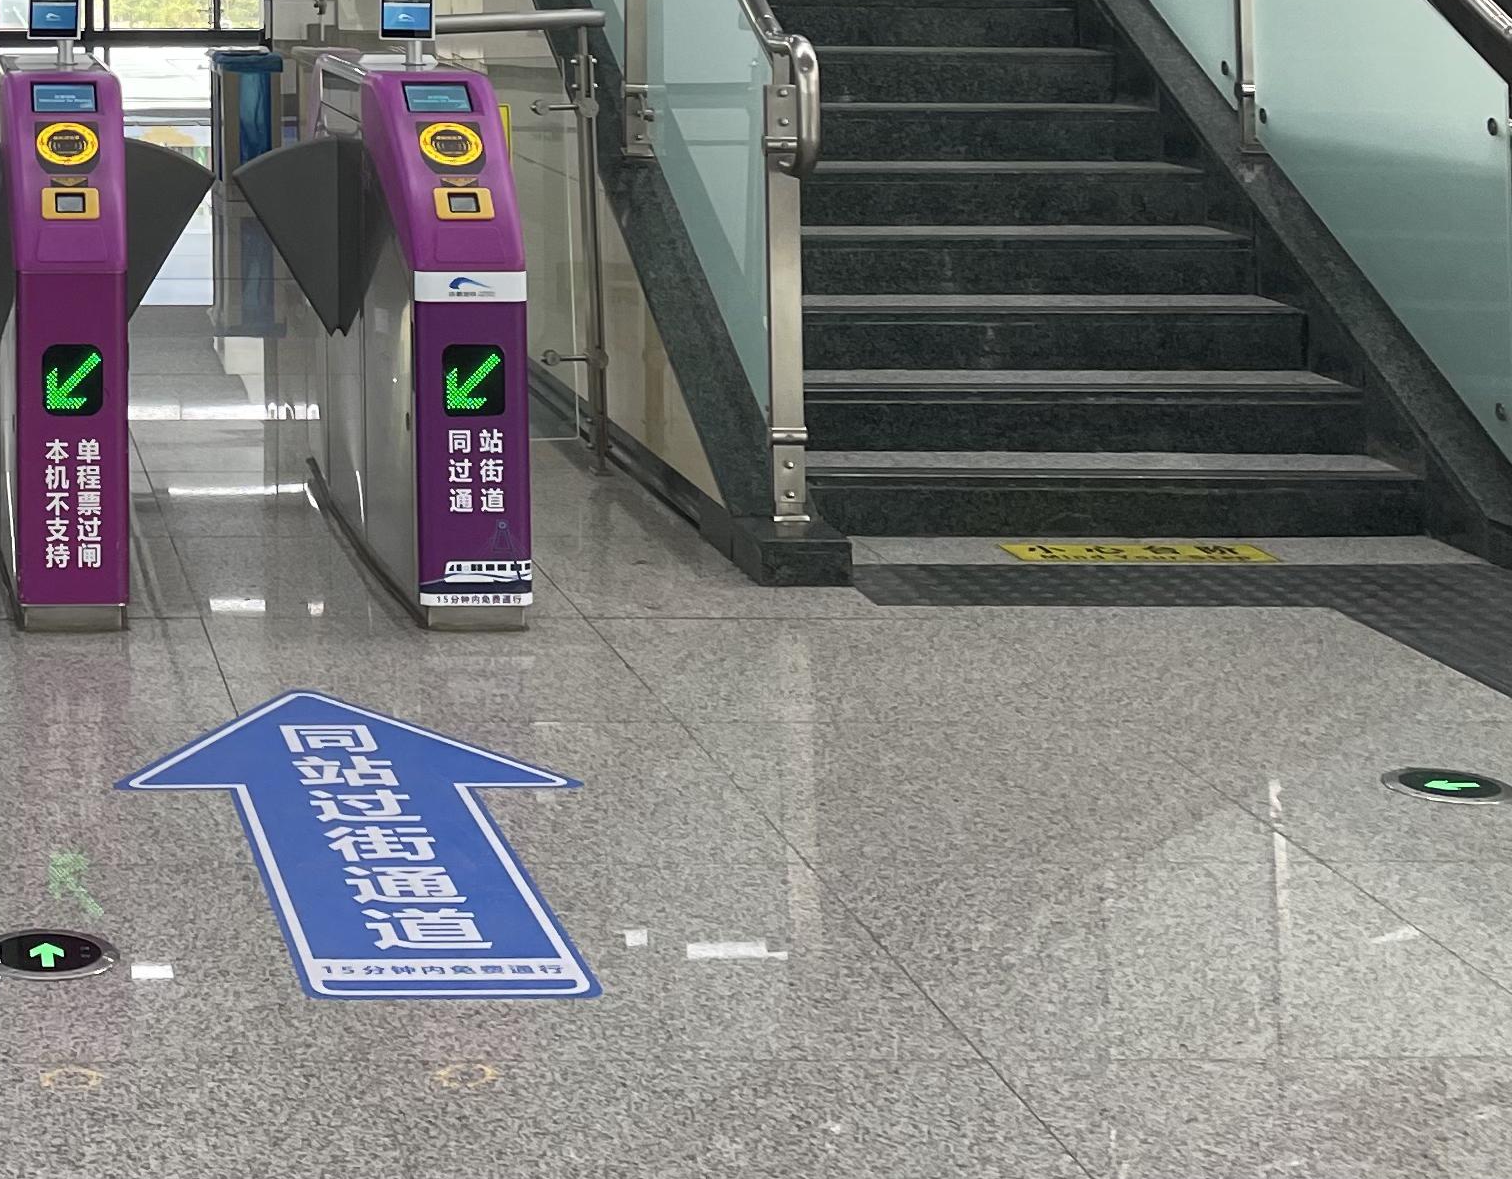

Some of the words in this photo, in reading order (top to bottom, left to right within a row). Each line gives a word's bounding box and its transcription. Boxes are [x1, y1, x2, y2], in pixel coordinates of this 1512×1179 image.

[448, 428, 504, 454] 同站
[448, 458, 505, 484] 过街
[45, 438, 70, 569] 本机不支持
[76, 438, 102, 569] 单程票过闸
[449, 487, 506, 514] 通道
[436, 594, 522, 605] 15分钟内免费通行
[278, 723, 493, 951] 同站过街通道
[321, 965, 564, 975] 15分钟内免费通行
